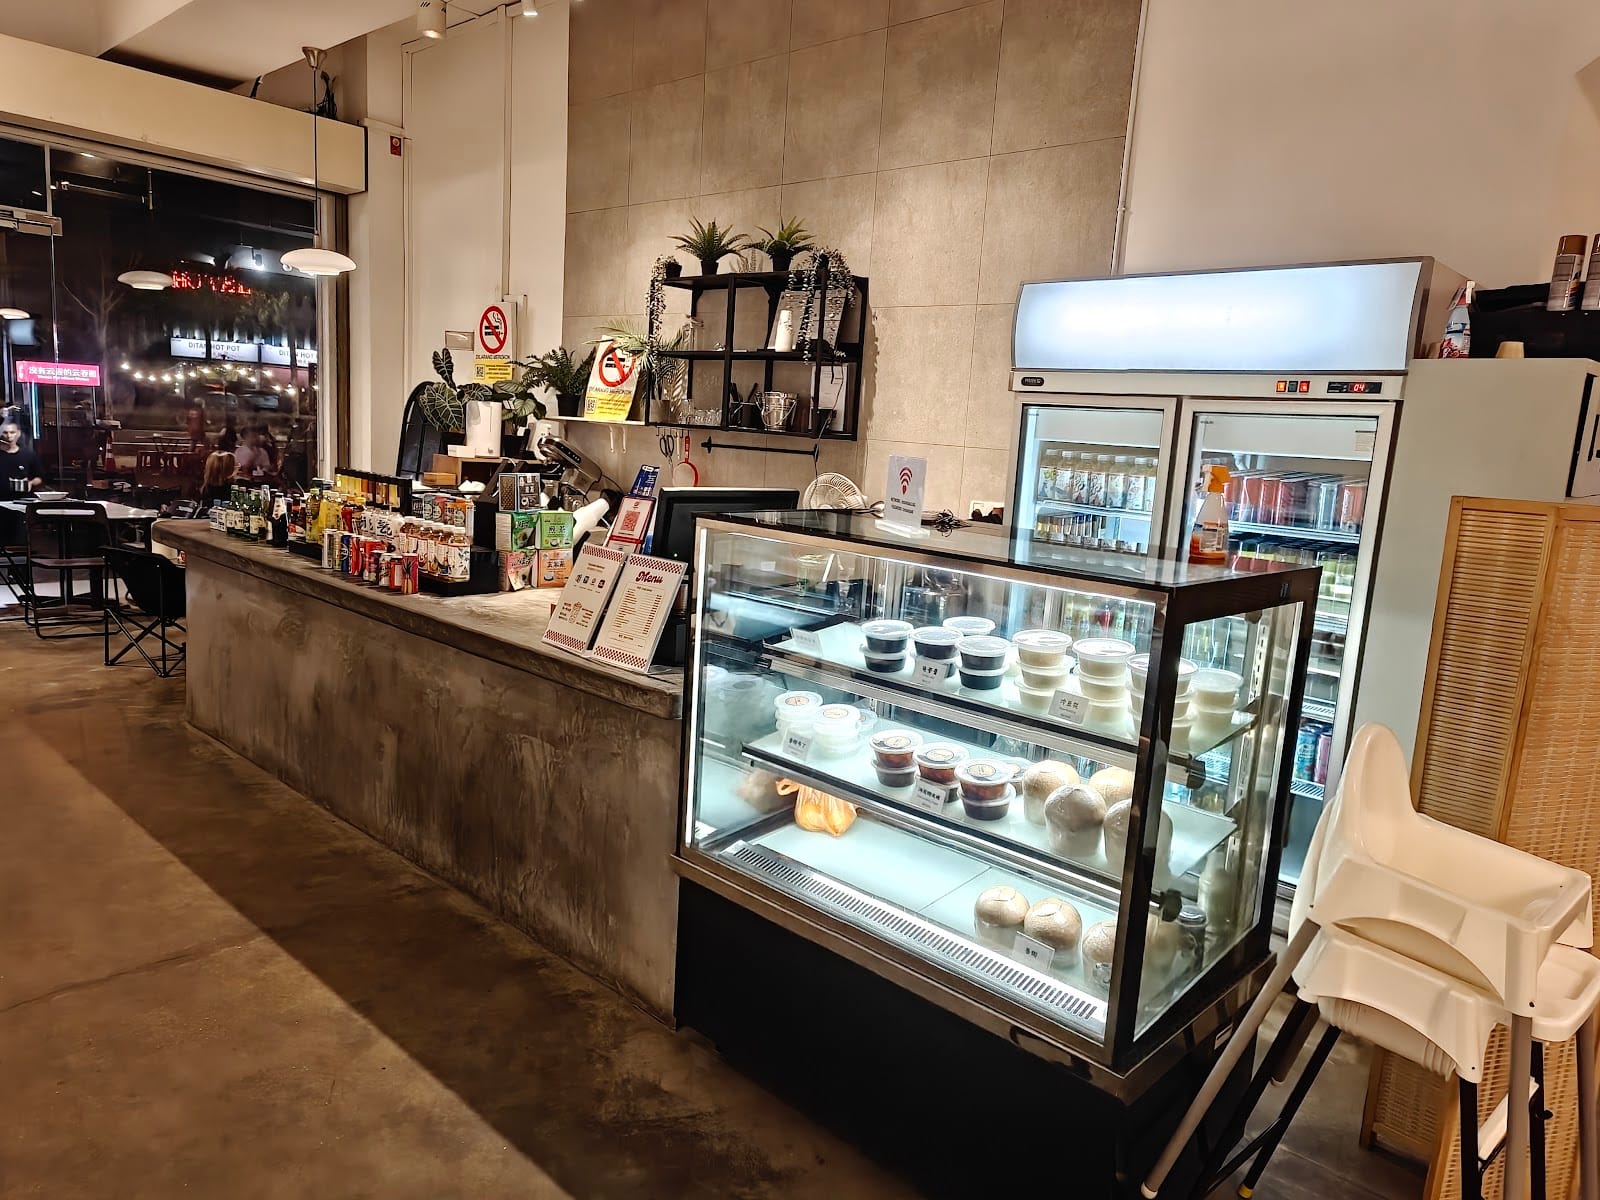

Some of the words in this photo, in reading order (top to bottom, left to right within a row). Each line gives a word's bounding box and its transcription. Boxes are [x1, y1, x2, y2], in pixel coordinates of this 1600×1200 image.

[278, 349, 299, 357] DITN
[301, 351, 314, 359] HOT
[635, 570, 664, 585] Menu
